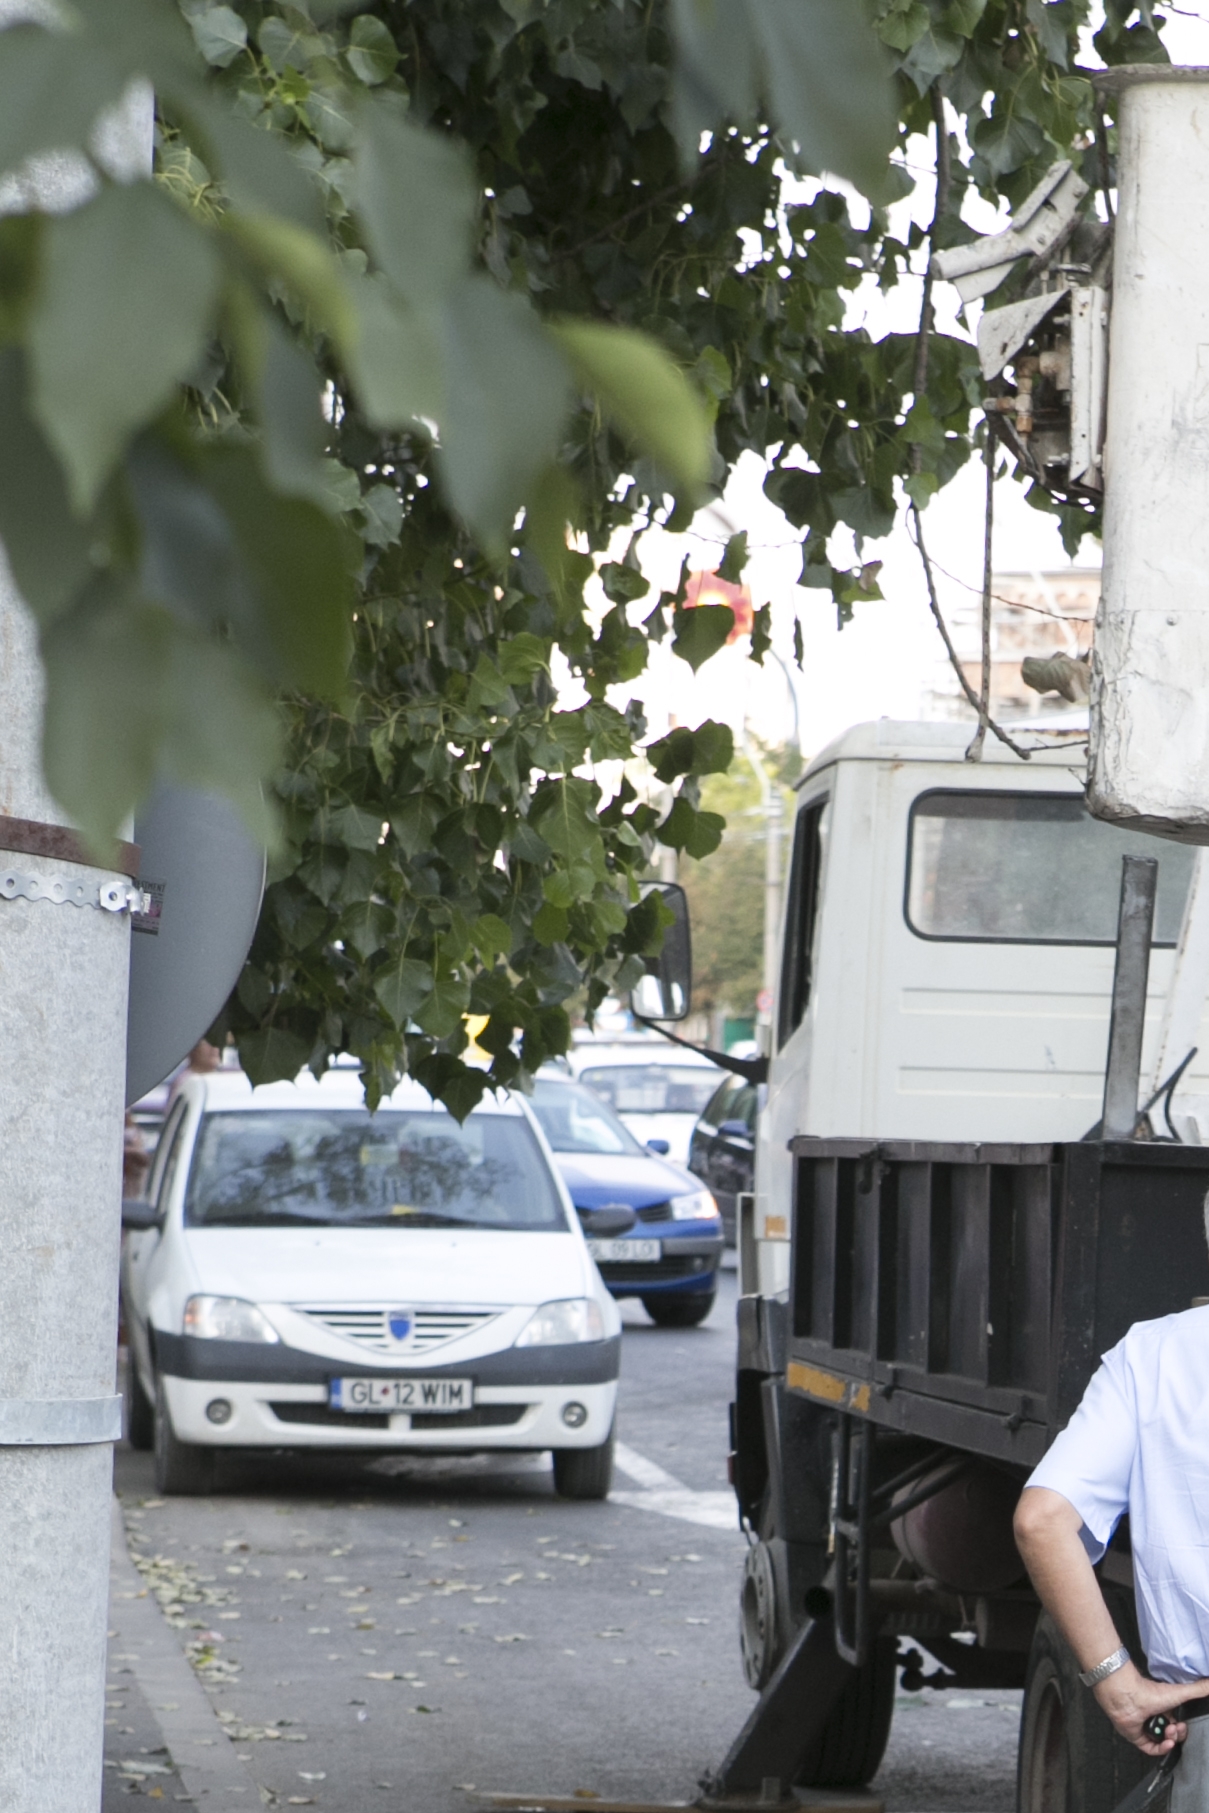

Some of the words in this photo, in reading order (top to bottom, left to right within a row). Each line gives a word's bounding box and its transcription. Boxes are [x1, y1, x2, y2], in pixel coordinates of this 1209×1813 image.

[351, 1382, 381, 1404] GL
[393, 1383, 415, 1405] 12
[422, 1383, 463, 1405] WIM
